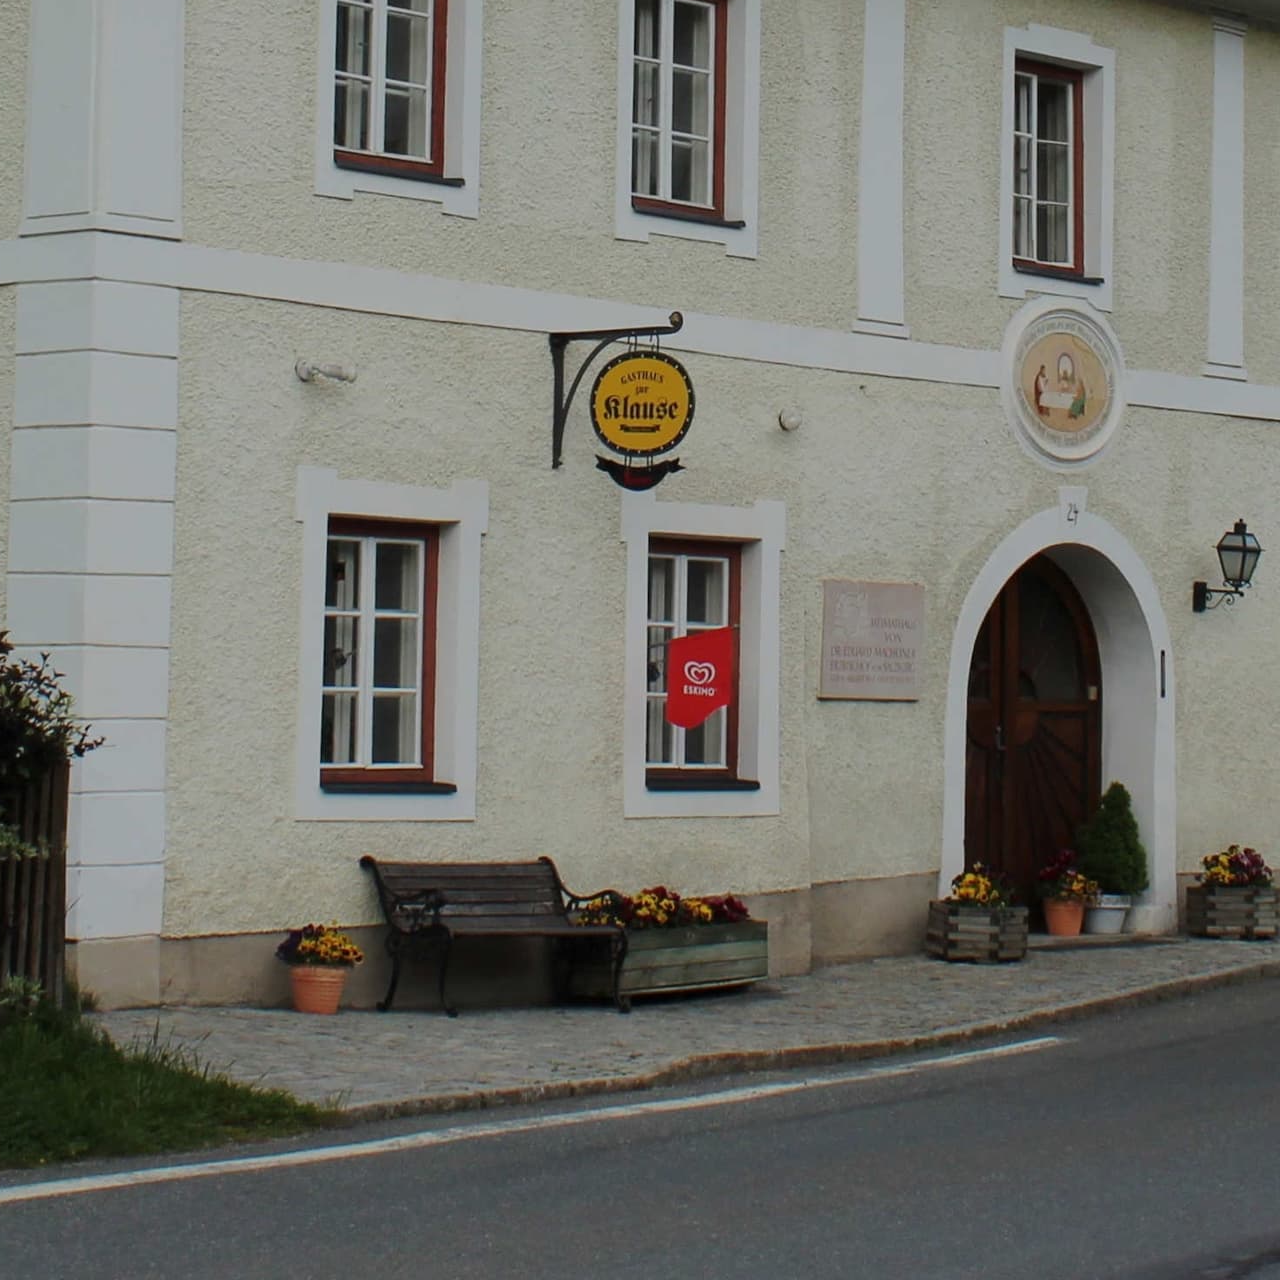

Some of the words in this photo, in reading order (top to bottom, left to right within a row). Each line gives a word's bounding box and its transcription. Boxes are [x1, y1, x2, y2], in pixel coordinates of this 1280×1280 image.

[621, 371, 664, 384] GASTHAUS
[604, 395, 678, 419] Klause
[683, 685, 715, 696] ESKIMO
